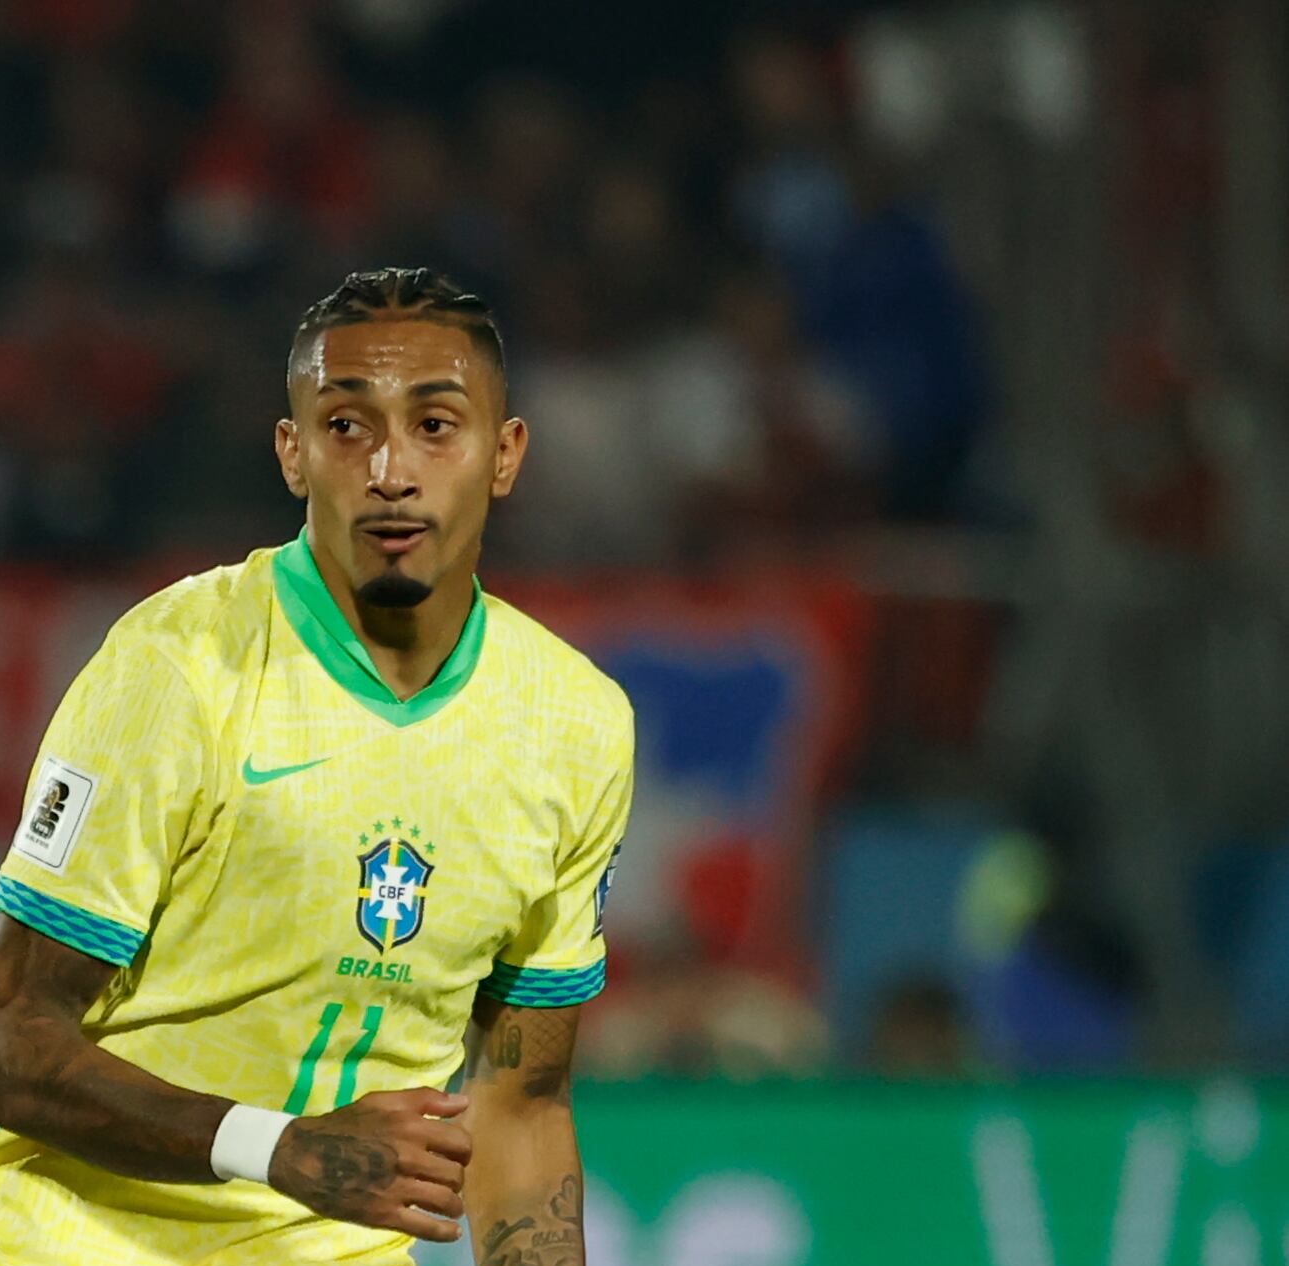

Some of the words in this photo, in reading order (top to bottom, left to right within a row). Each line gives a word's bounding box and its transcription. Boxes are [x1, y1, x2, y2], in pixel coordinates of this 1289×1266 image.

[378, 884, 406, 901] CBF
[336, 956, 414, 984] BRASIL
[282, 1001, 384, 1117] 11
